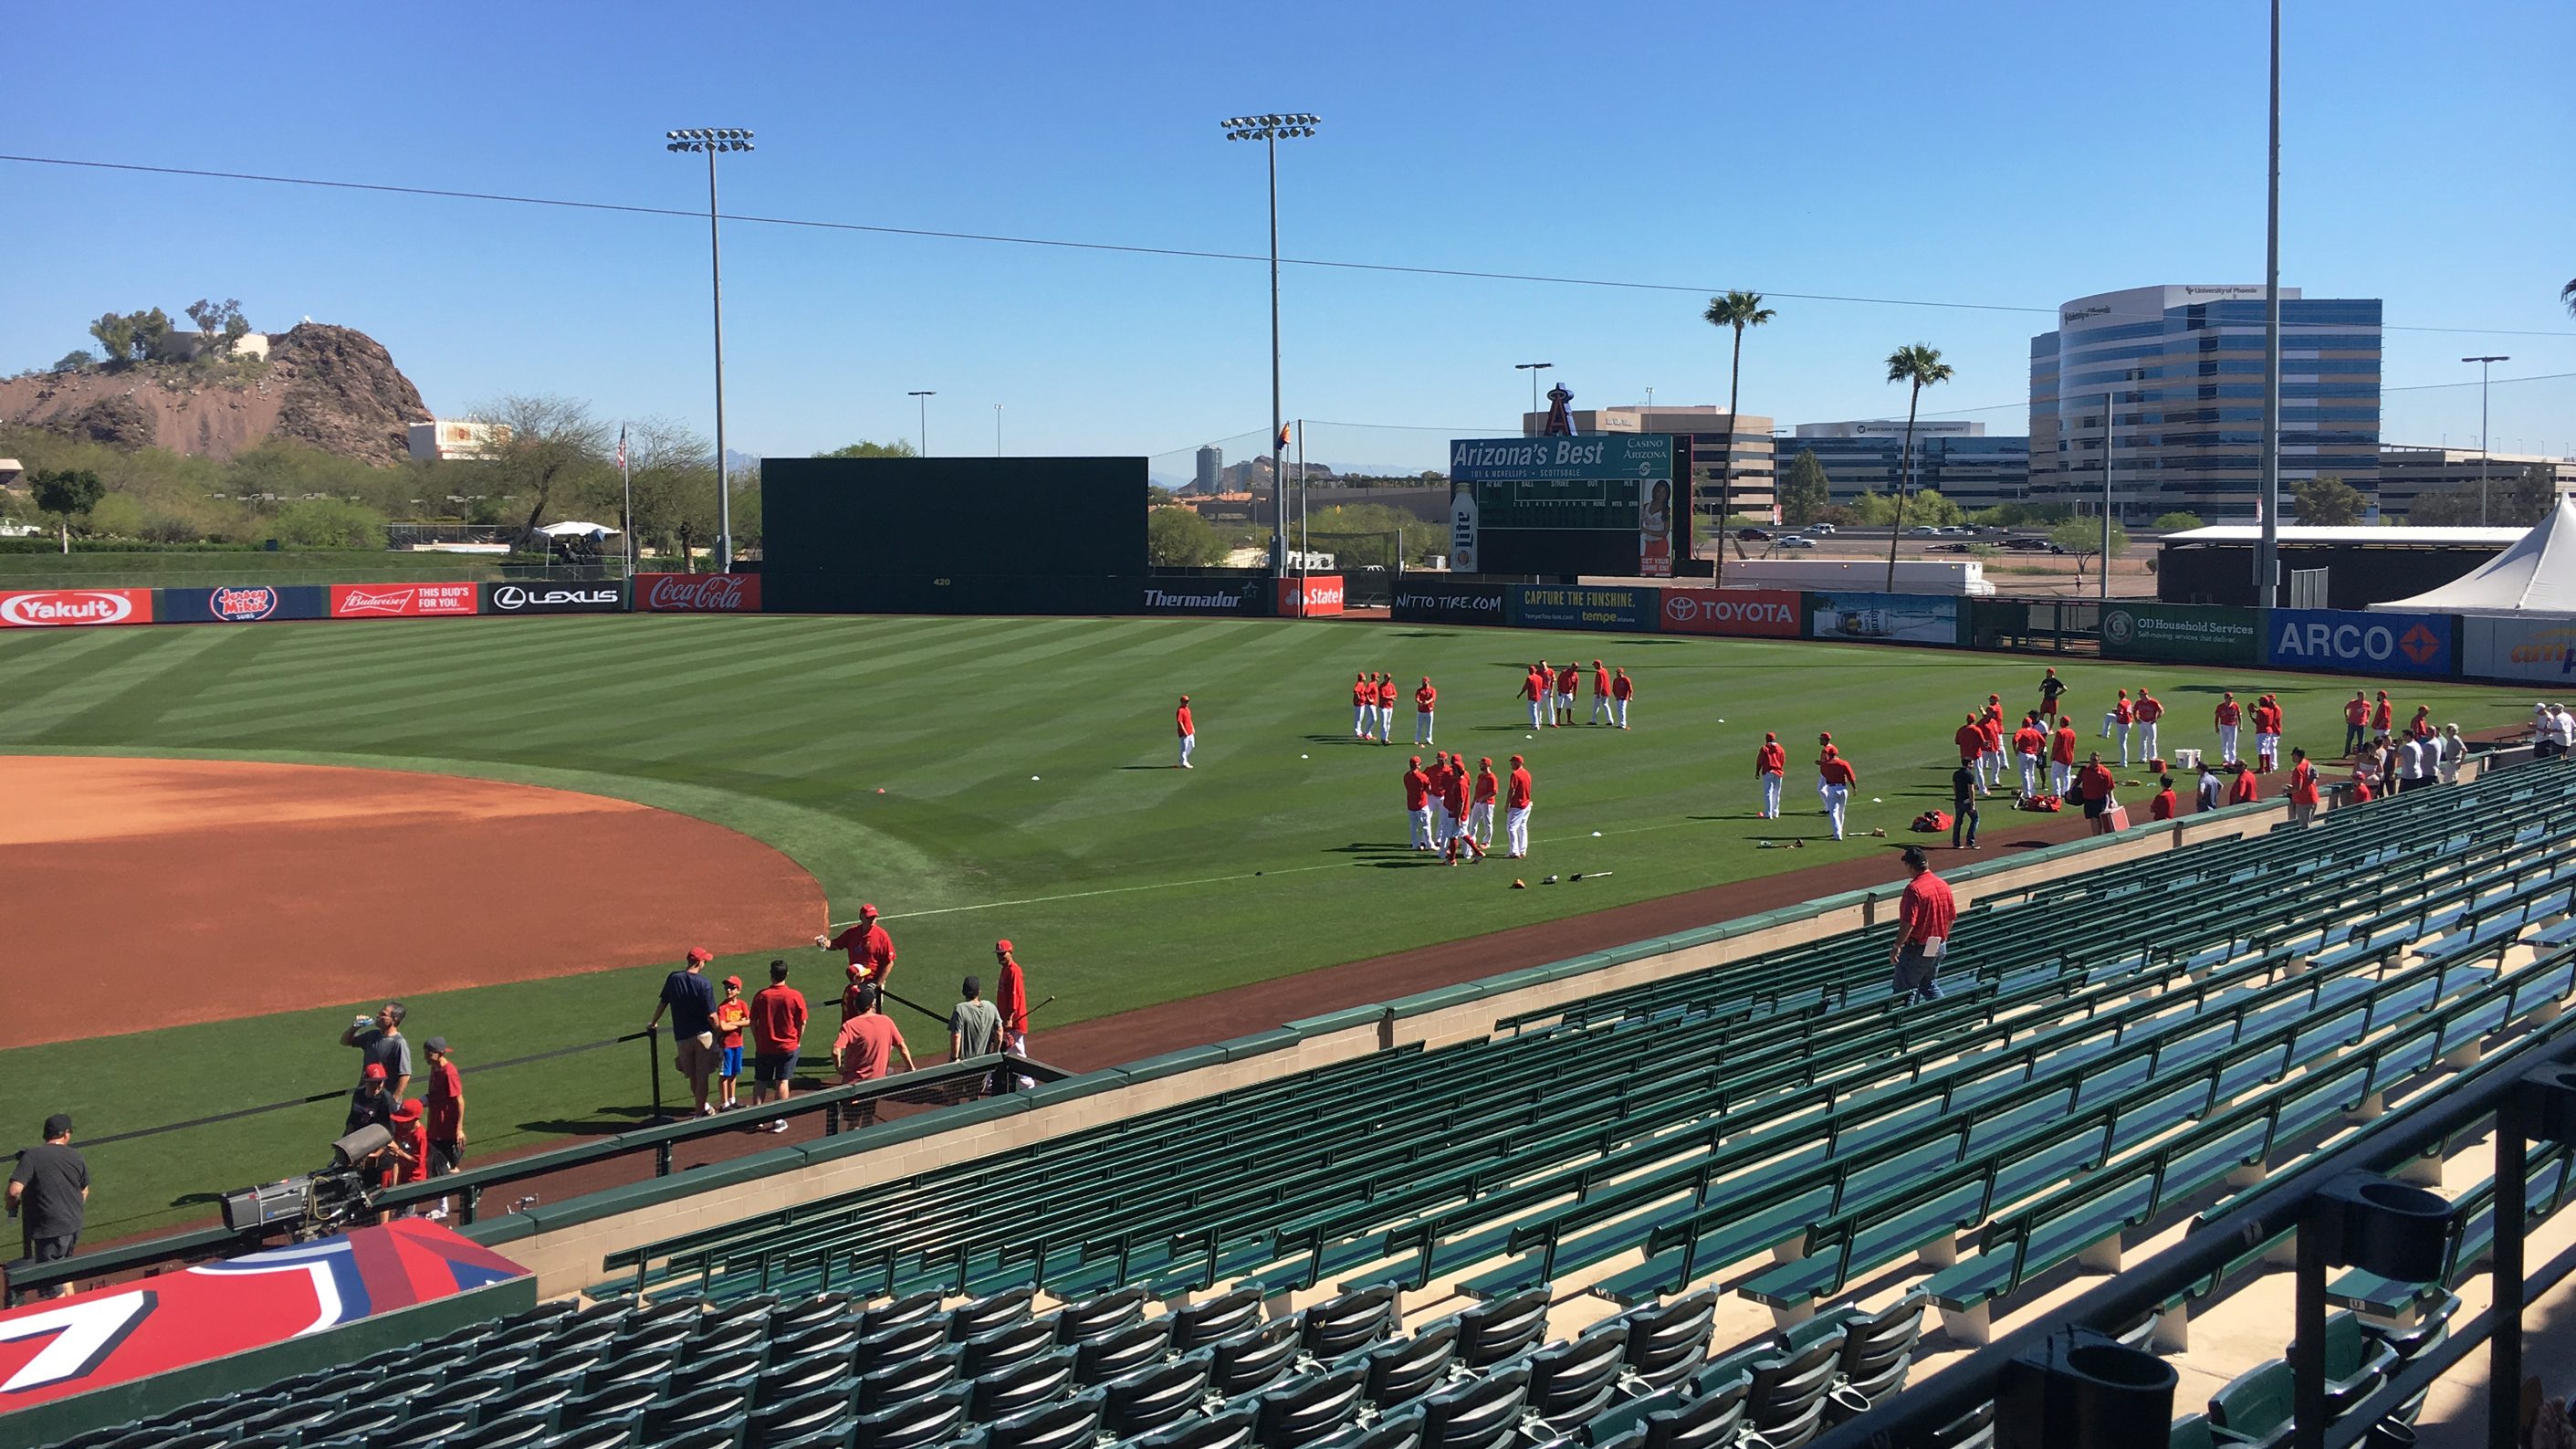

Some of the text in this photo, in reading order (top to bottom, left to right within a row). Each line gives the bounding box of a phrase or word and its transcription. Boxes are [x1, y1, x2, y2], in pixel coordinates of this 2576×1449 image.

[1452, 440, 1605, 467] Arizona's Best
[1540, 468, 1581, 478] SCOTTSDALE
[1455, 511, 1474, 548] Lite
[933, 578, 951, 586] 420
[219, 589, 268, 604] Jersey
[418, 587, 469, 597] THIS BUD'S
[529, 590, 618, 604] LEXUS
[1144, 590, 1241, 607] Thermador
[1524, 591, 1636, 607] CAPTURE THE FUNSHINE.
[345, 595, 407, 606] Budweiser
[419, 598, 460, 608] FOR YOU.
[1396, 593, 1502, 613] NITTO TIRE.COM
[20, 601, 113, 618] Yakult
[1582, 611, 1618, 624] tempe
[1702, 602, 1793, 623] TOYOTA
[2138, 618, 2254, 634] OD Household Services
[2278, 622, 2393, 660] ARCO
